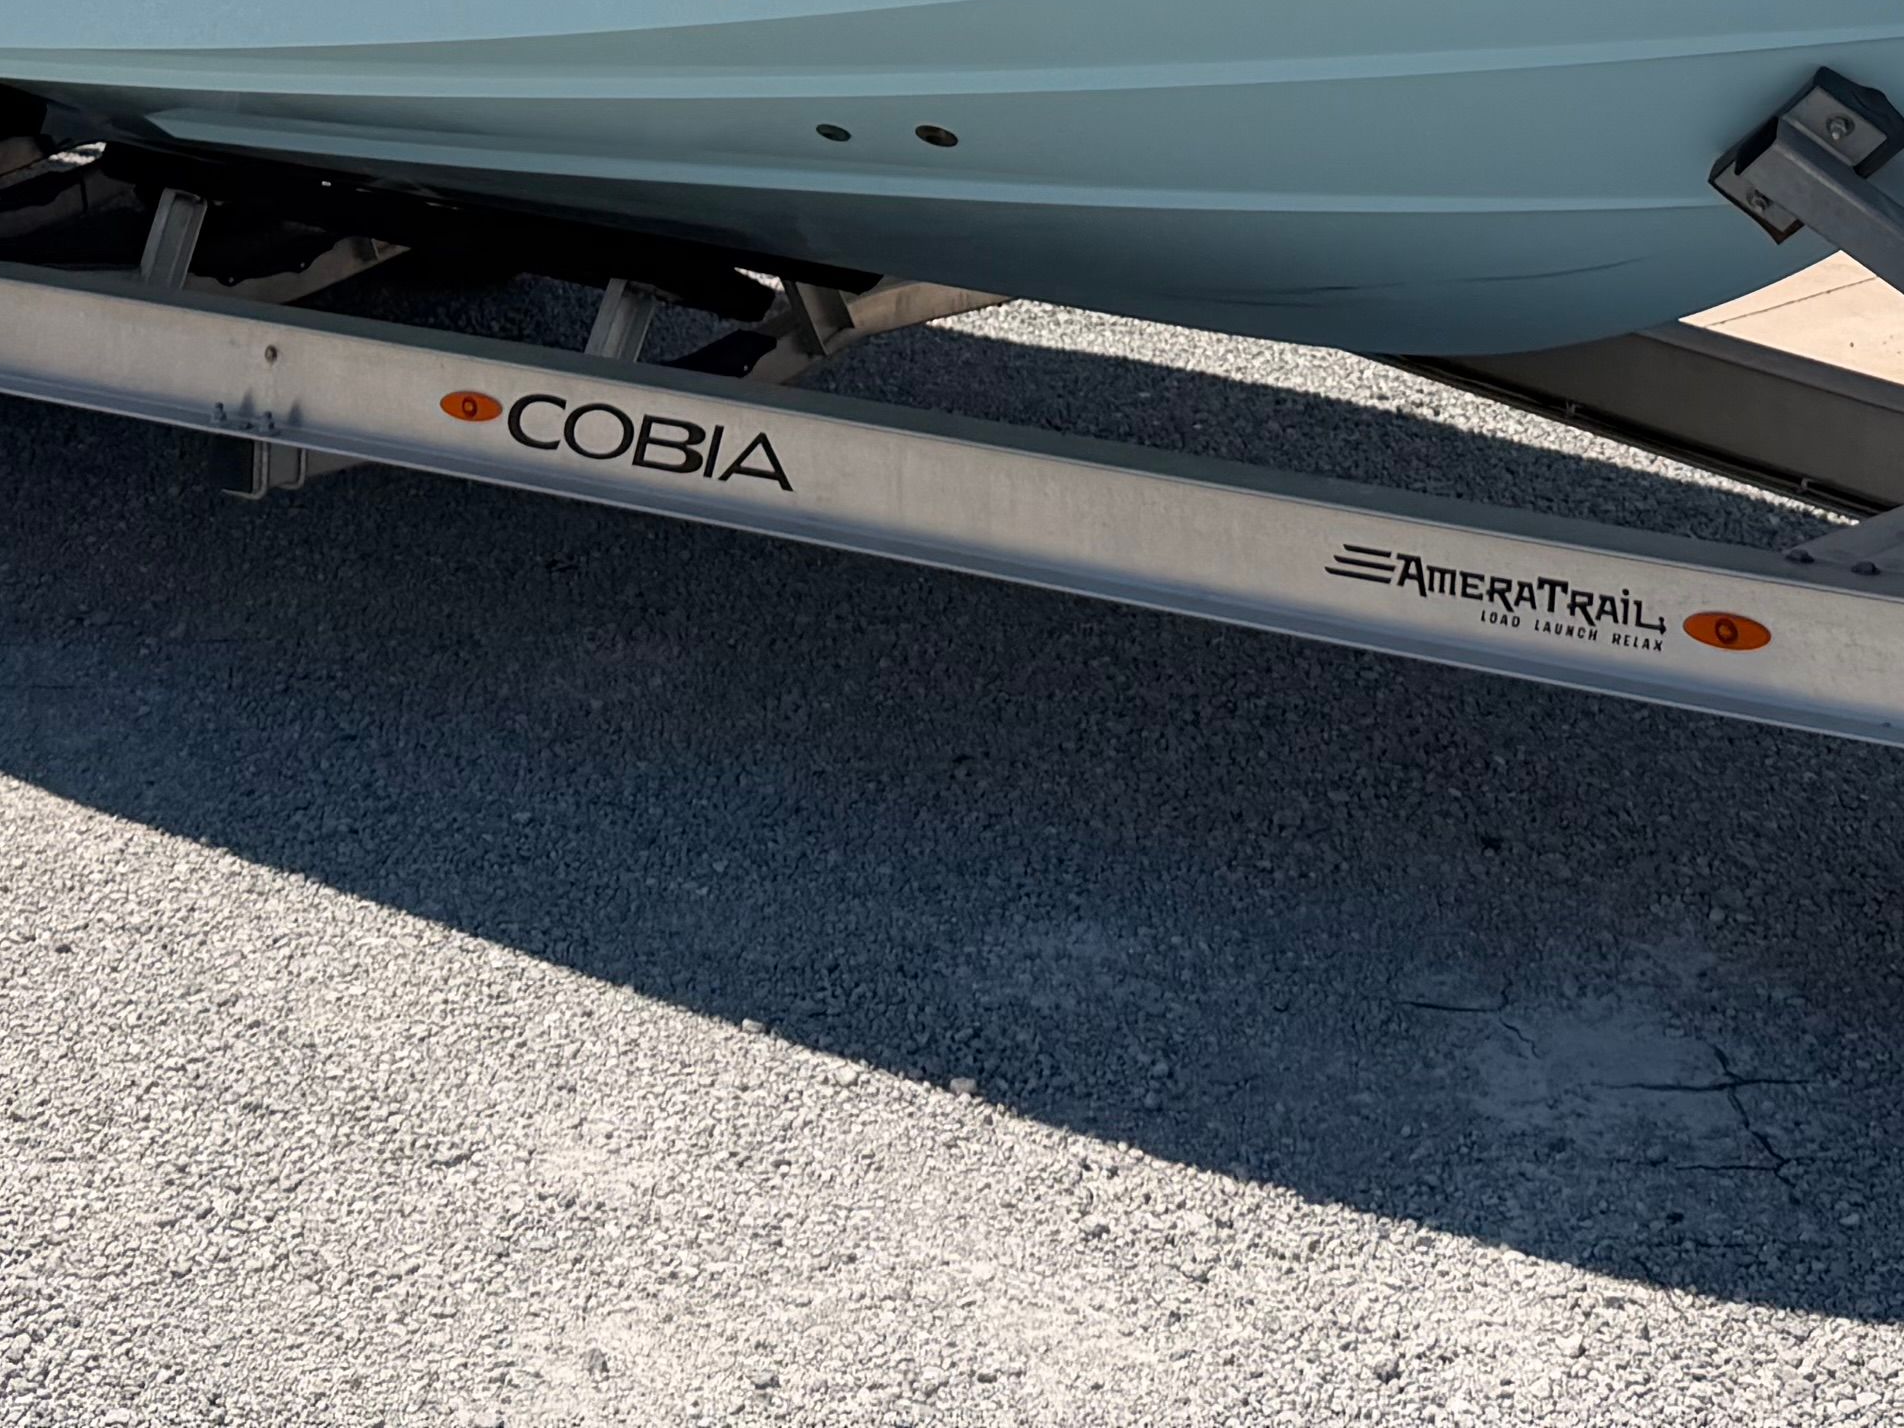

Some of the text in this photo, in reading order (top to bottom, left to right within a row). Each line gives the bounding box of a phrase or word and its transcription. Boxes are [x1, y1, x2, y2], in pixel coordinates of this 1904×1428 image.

[507, 392, 795, 493] COBIA
[1480, 610, 1663, 653] LOAD LAUNCH RELAX
